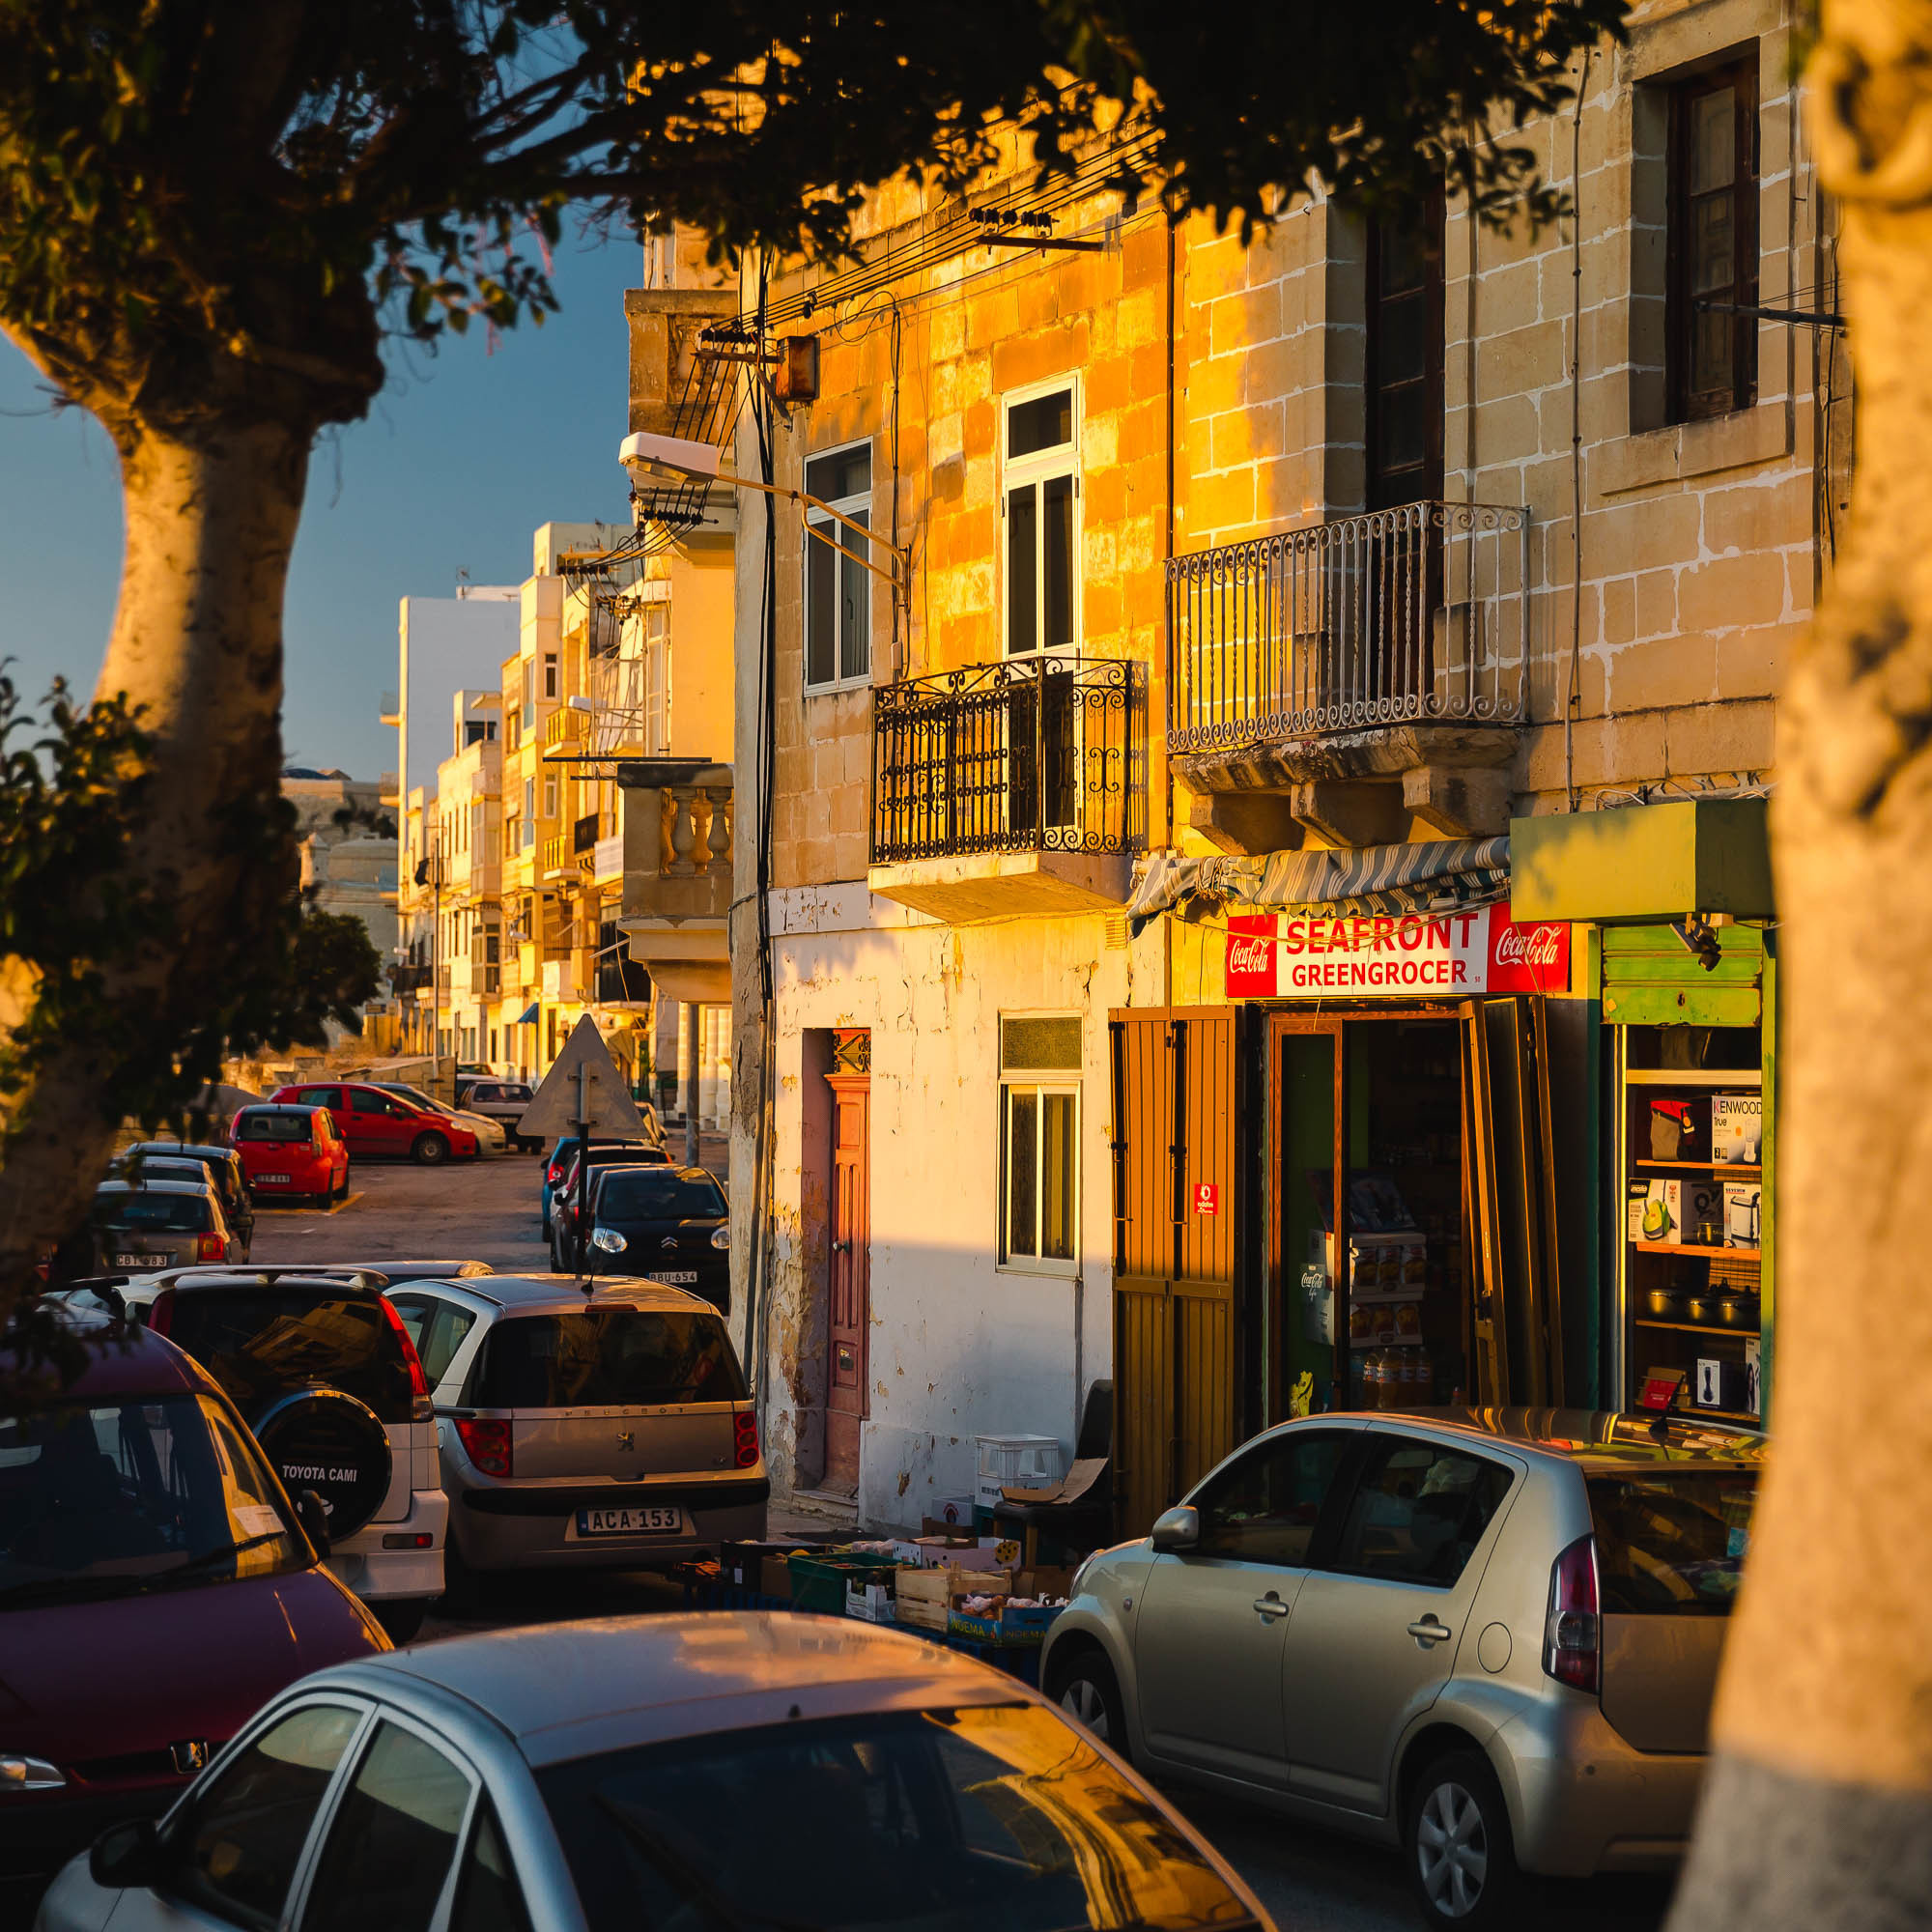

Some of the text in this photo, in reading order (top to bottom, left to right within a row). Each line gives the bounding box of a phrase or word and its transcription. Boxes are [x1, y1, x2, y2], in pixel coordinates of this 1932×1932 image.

[1287, 913, 1478, 954] SEAFRONT
[1496, 926, 1563, 965] Coca-Cola
[1230, 939, 1270, 973] Coca-Cola
[1293, 959, 1467, 986] GREENGROCER
[1714, 1100, 1762, 1114] KENWOOD
[282, 1465, 357, 1482] TOYOTA CAMI
